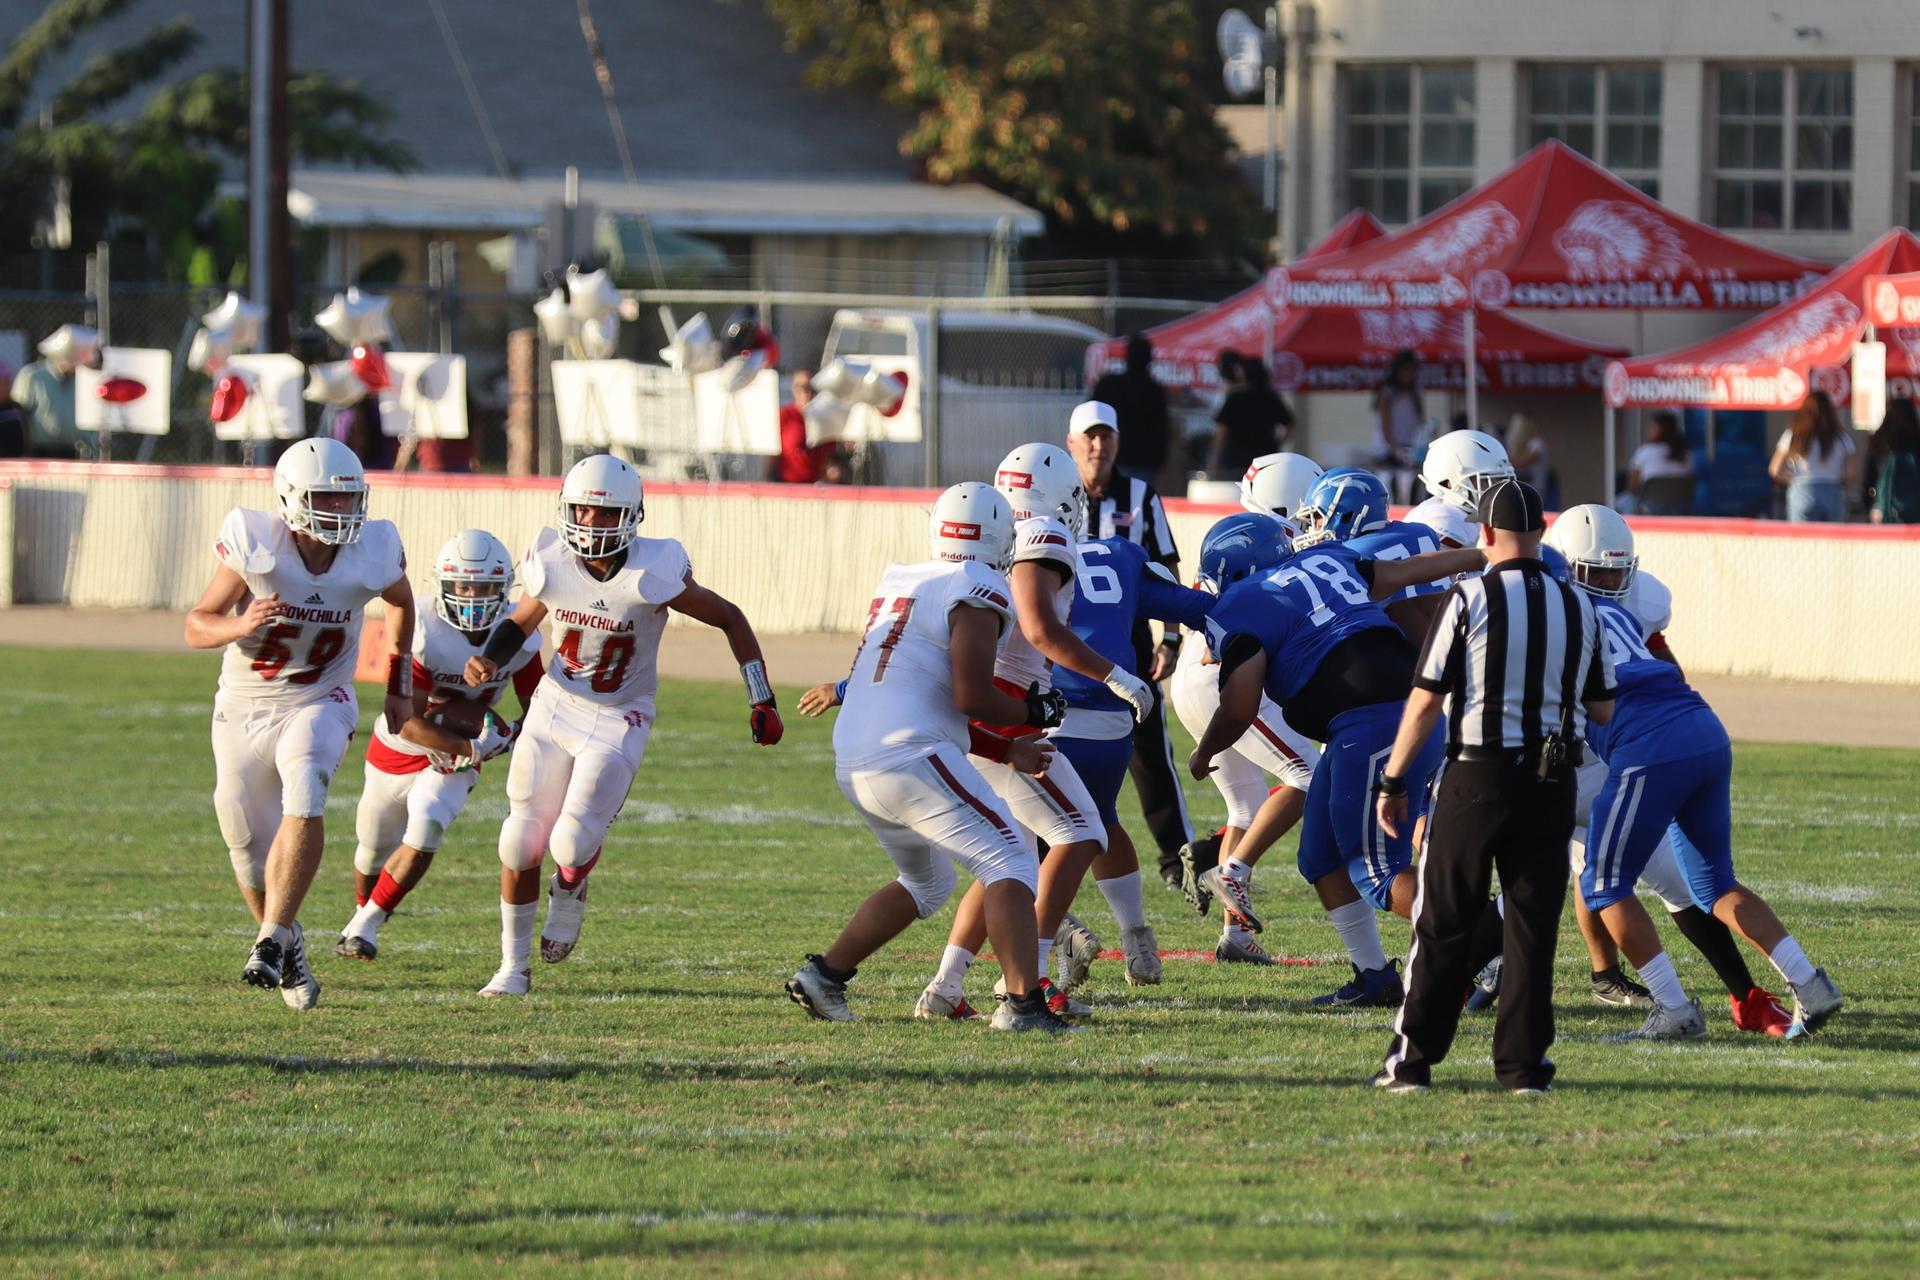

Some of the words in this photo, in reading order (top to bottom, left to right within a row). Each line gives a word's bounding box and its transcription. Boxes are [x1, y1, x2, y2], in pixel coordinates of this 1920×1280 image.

[1512, 282, 1702, 309] CHOWCHILLA
[940, 551, 976, 561] Riddell
[1267, 554, 1370, 627] 78
[555, 608, 634, 633] CHOWCHILLA
